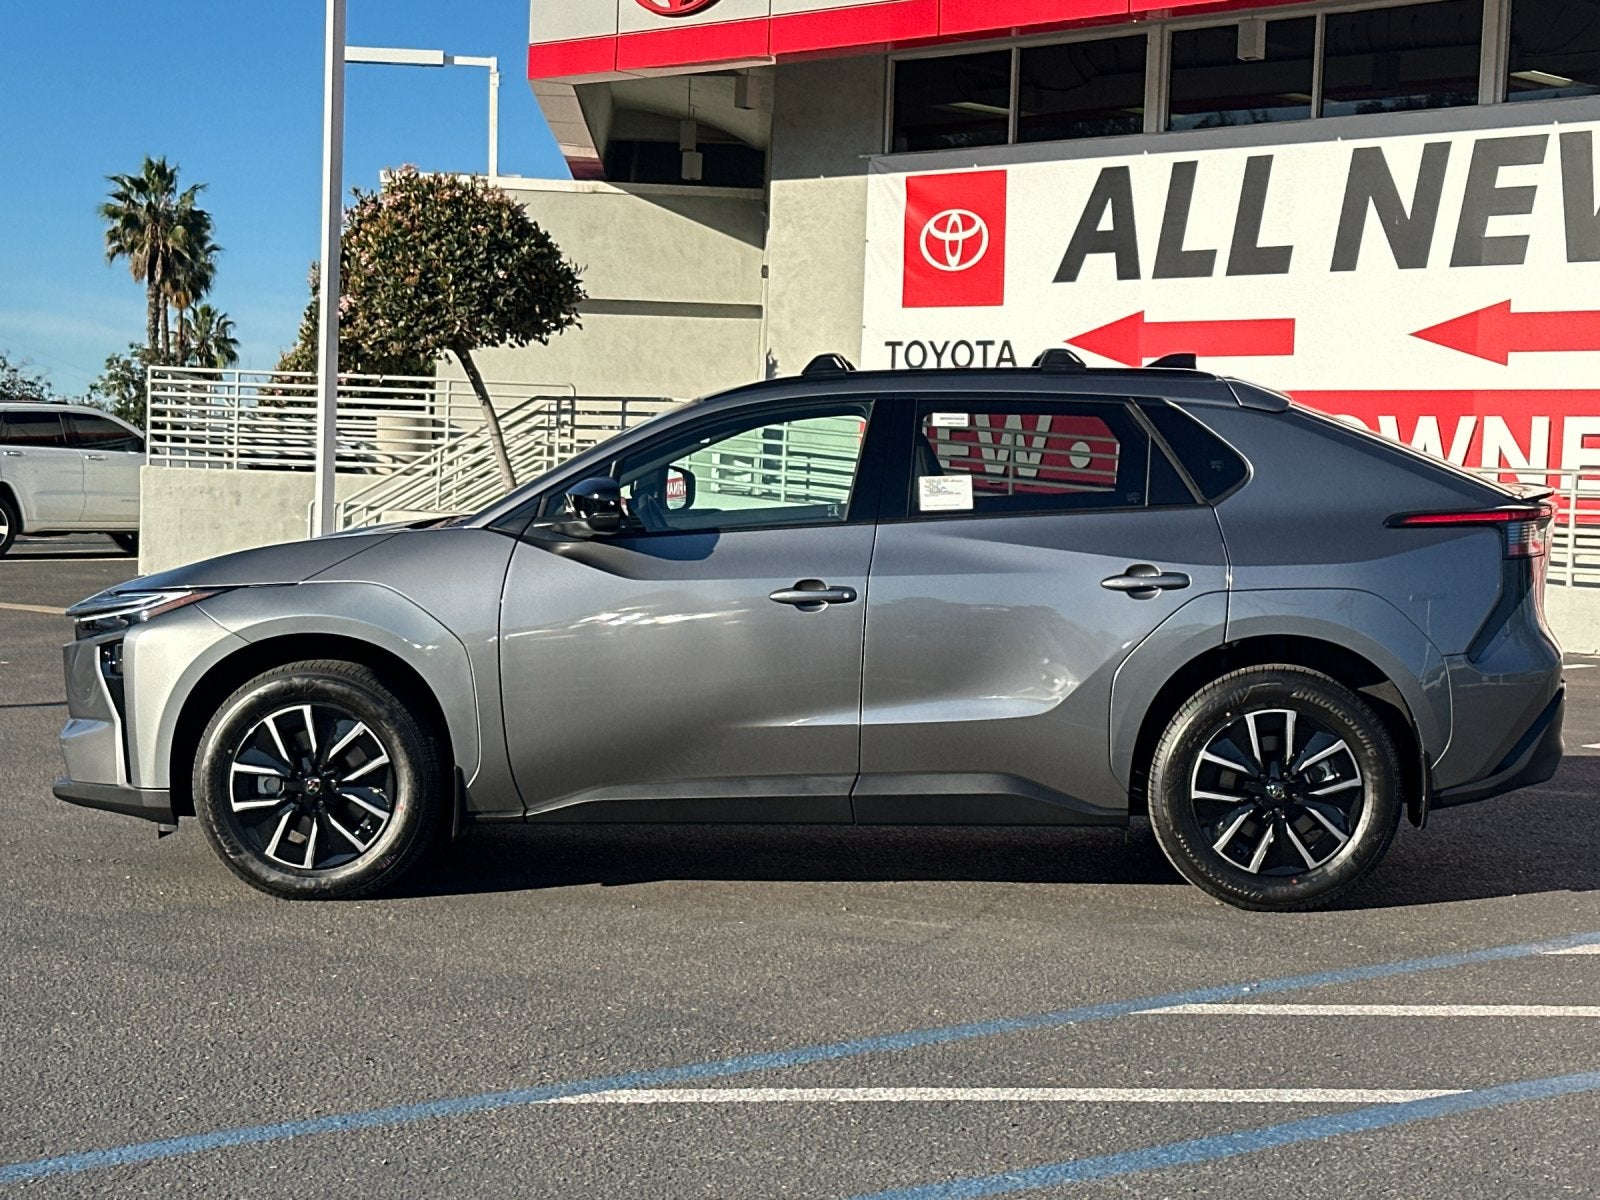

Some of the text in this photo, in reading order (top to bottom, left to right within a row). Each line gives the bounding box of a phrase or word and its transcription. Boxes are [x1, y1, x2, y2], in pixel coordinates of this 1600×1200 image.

[1051, 154, 1294, 283] ALL
[884, 339, 1018, 370] TOYOTA
[1333, 414, 1600, 498] WNE
